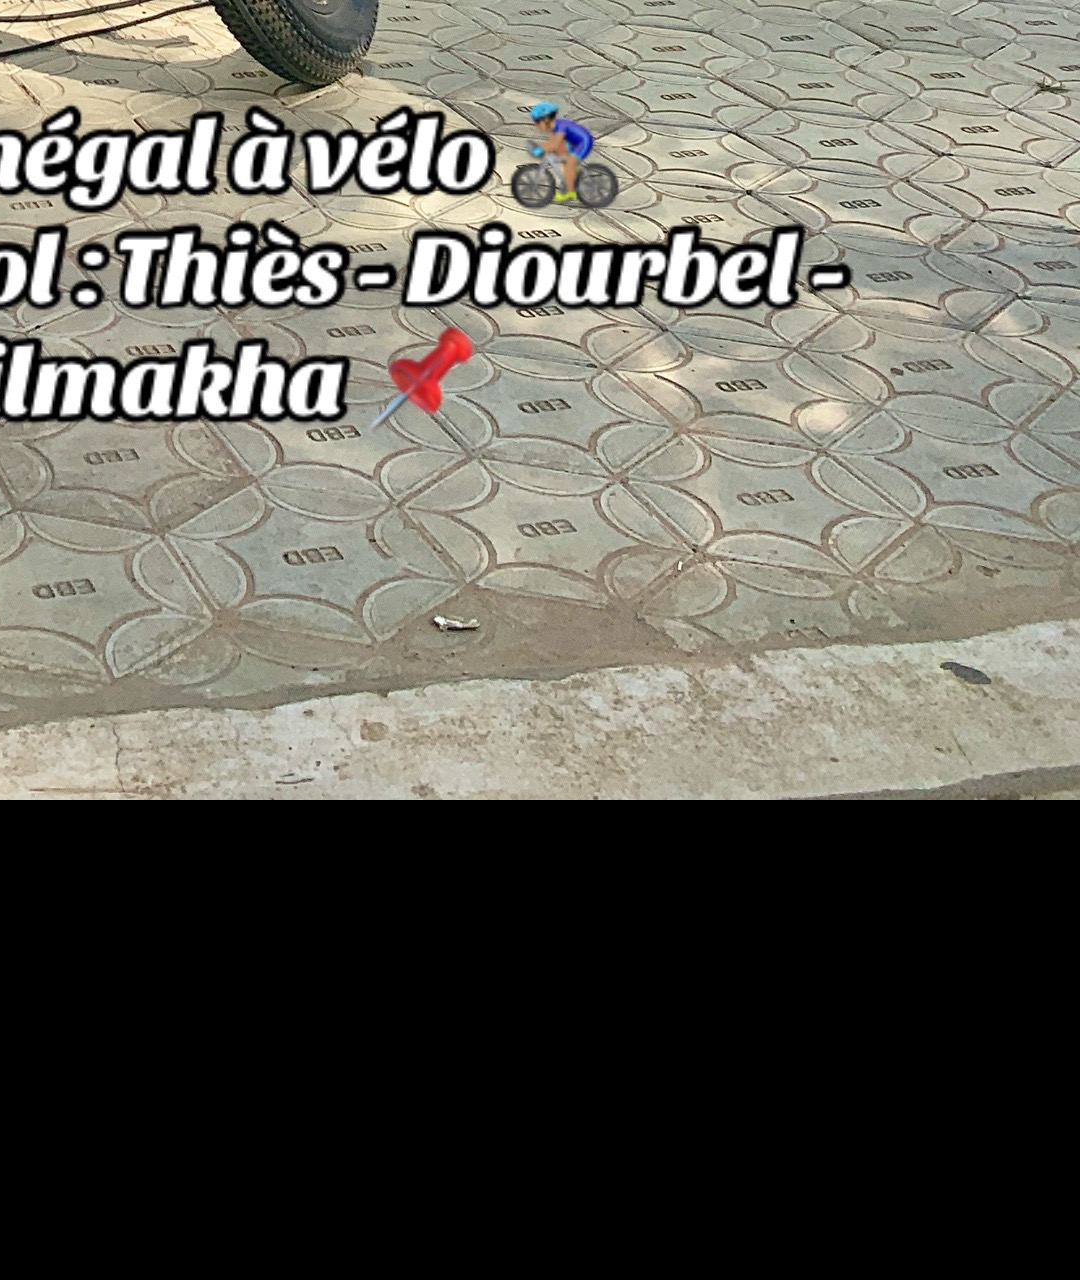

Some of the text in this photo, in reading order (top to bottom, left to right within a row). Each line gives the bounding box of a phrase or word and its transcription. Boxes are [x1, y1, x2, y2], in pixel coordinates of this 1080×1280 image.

[518, 398, 572, 414] EBD
[306, 424, 362, 443] EBD
[942, 463, 1000, 480] EBD
[736, 489, 796, 507] EBD
[517, 519, 578, 538] EBD
[282, 545, 344, 567] EBD
